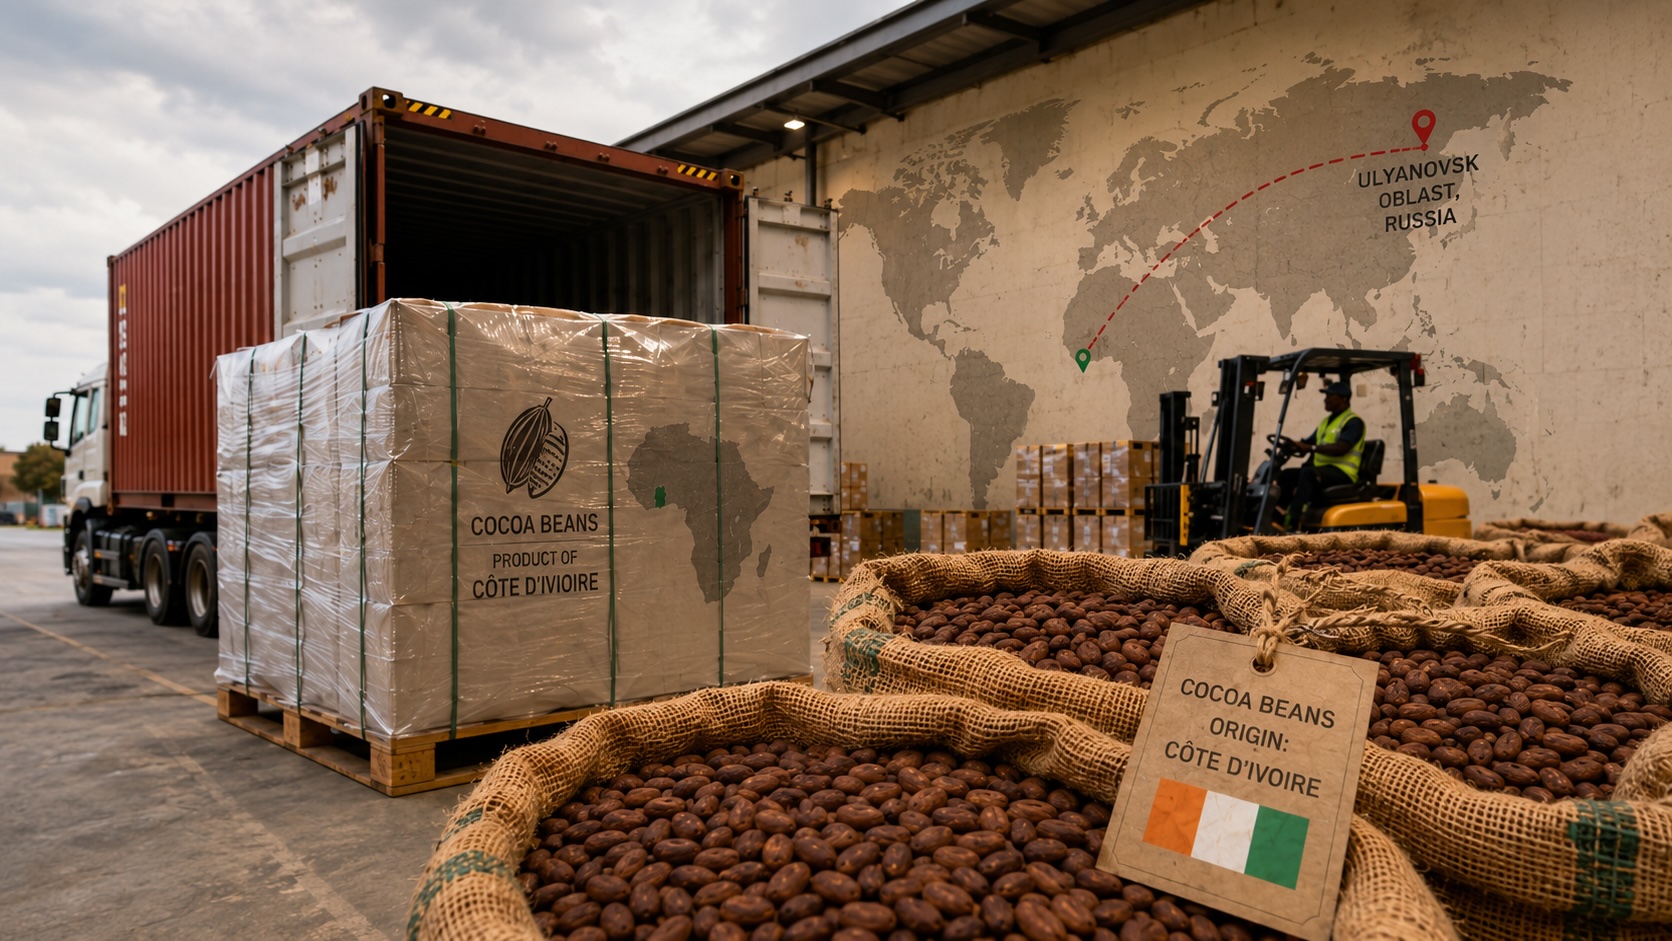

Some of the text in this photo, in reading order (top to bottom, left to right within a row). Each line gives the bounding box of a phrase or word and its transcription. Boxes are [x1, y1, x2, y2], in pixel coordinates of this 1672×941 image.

[1358, 153, 1479, 188] ULYANOVSK
[1379, 182, 1460, 209] OBLAST,
[1385, 207, 1457, 232] RUSSIA
[471, 513, 598, 536] COCOA BEANS
[493, 550, 578, 568] PRODUCT OF
[472, 574, 520, 599] CÔTE
[1180, 678, 1335, 729] COCOA BEANS
[1209, 717, 1290, 752] ORIGIN:
[1164, 740, 1322, 799] CÔTE D’IVOIRE
